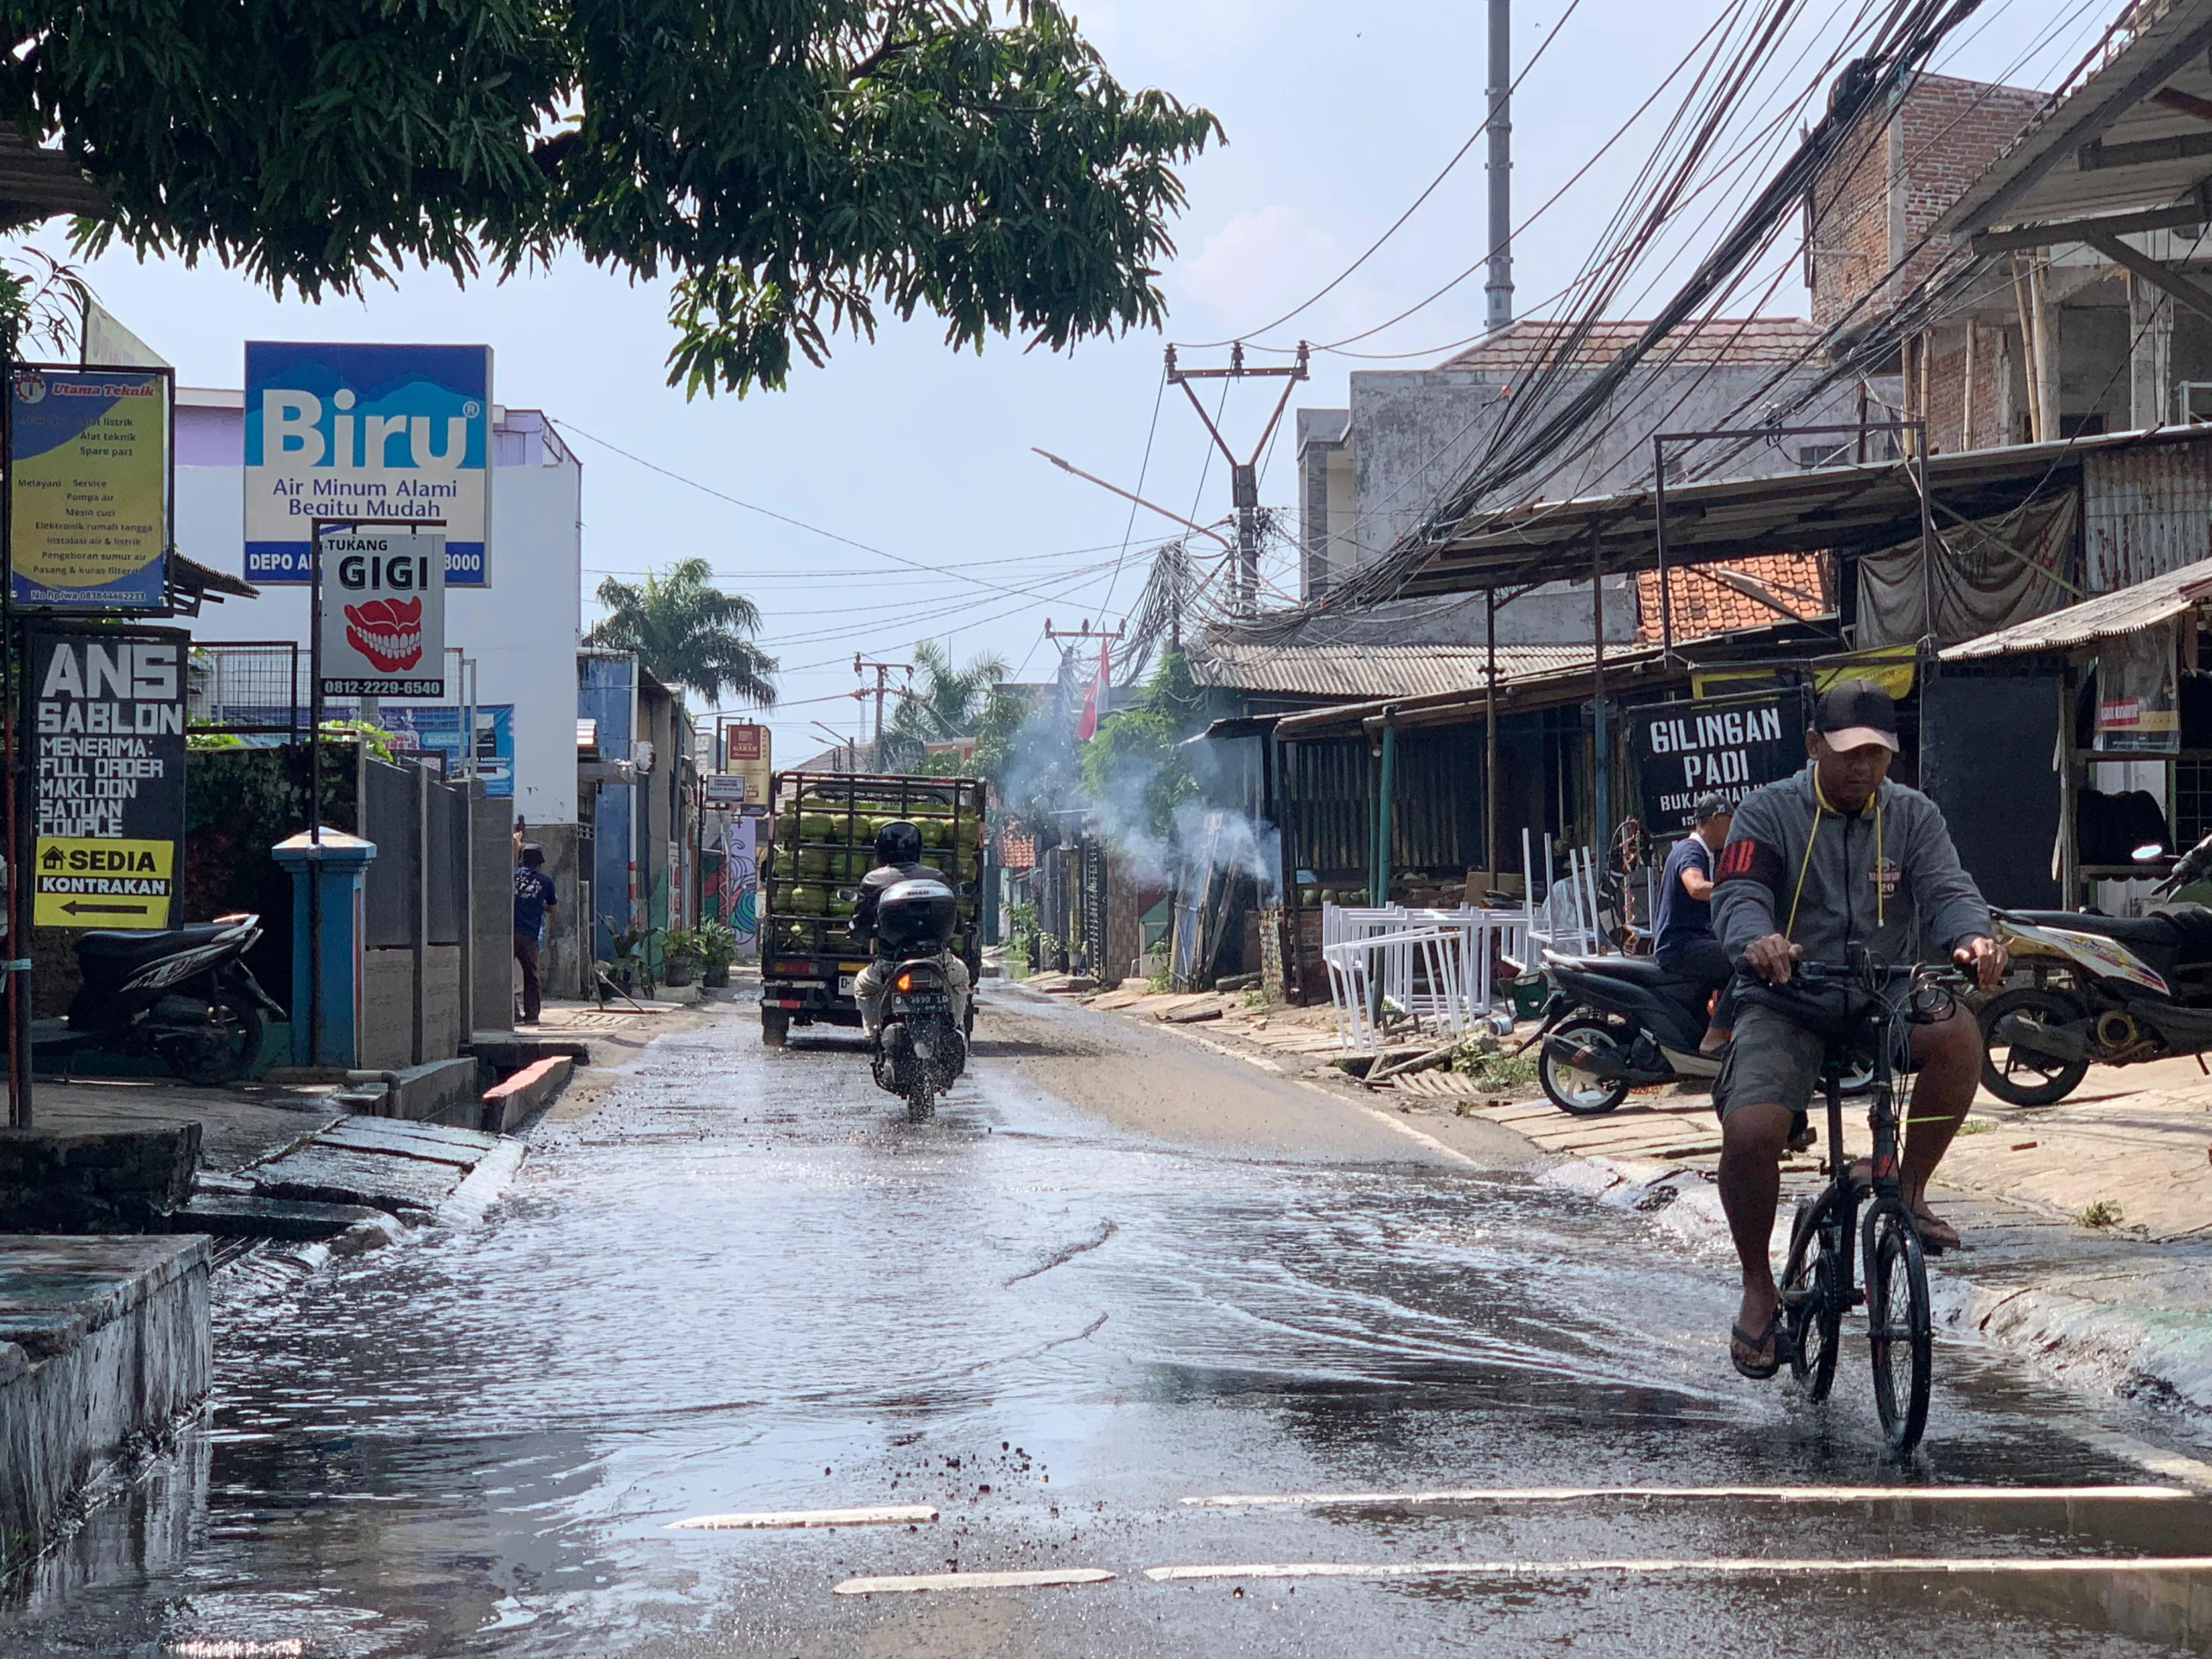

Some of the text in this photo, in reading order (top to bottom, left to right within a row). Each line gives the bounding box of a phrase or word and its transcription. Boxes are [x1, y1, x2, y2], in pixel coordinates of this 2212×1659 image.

[54, 383, 155, 397] Utama Teknik
[104, 418, 133, 427] listrik
[263, 388, 467, 468] Biru
[80, 432, 136, 442] Alat teknik
[80, 447, 132, 457] Spare part
[18, 479, 107, 489] Melayani Service
[272, 479, 457, 498] Air Minum Alami
[66, 493, 99, 503] Pompa
[66, 508, 116, 518] Mesin cuci
[366, 499, 440, 517] Mudah
[35, 521, 152, 534] Elektronik rumah tangga
[114, 537, 141, 546] listrik
[41, 551, 99, 562] Pengeboran
[249, 553, 293, 570] DEPO
[33, 566, 67, 576] Pasang
[339, 556, 428, 591] GIGI
[32, 591, 45, 600] No
[48, 591, 78, 602] hp/wa
[41, 643, 177, 699] ANS
[324, 680, 440, 694] 0812-2229-6540
[38, 702, 183, 734] SABLON
[1649, 708, 1782, 753] GILINGAN
[40, 737, 154, 757] MENERIMA:
[94, 758, 163, 778] ORDER
[1683, 749, 1750, 788] PADI
[39, 779, 137, 798] MAKLOON
[39, 799, 123, 818] SATUAN
[68, 850, 156, 872] SEDIA
[42, 877, 165, 894] KONTRAKAN
